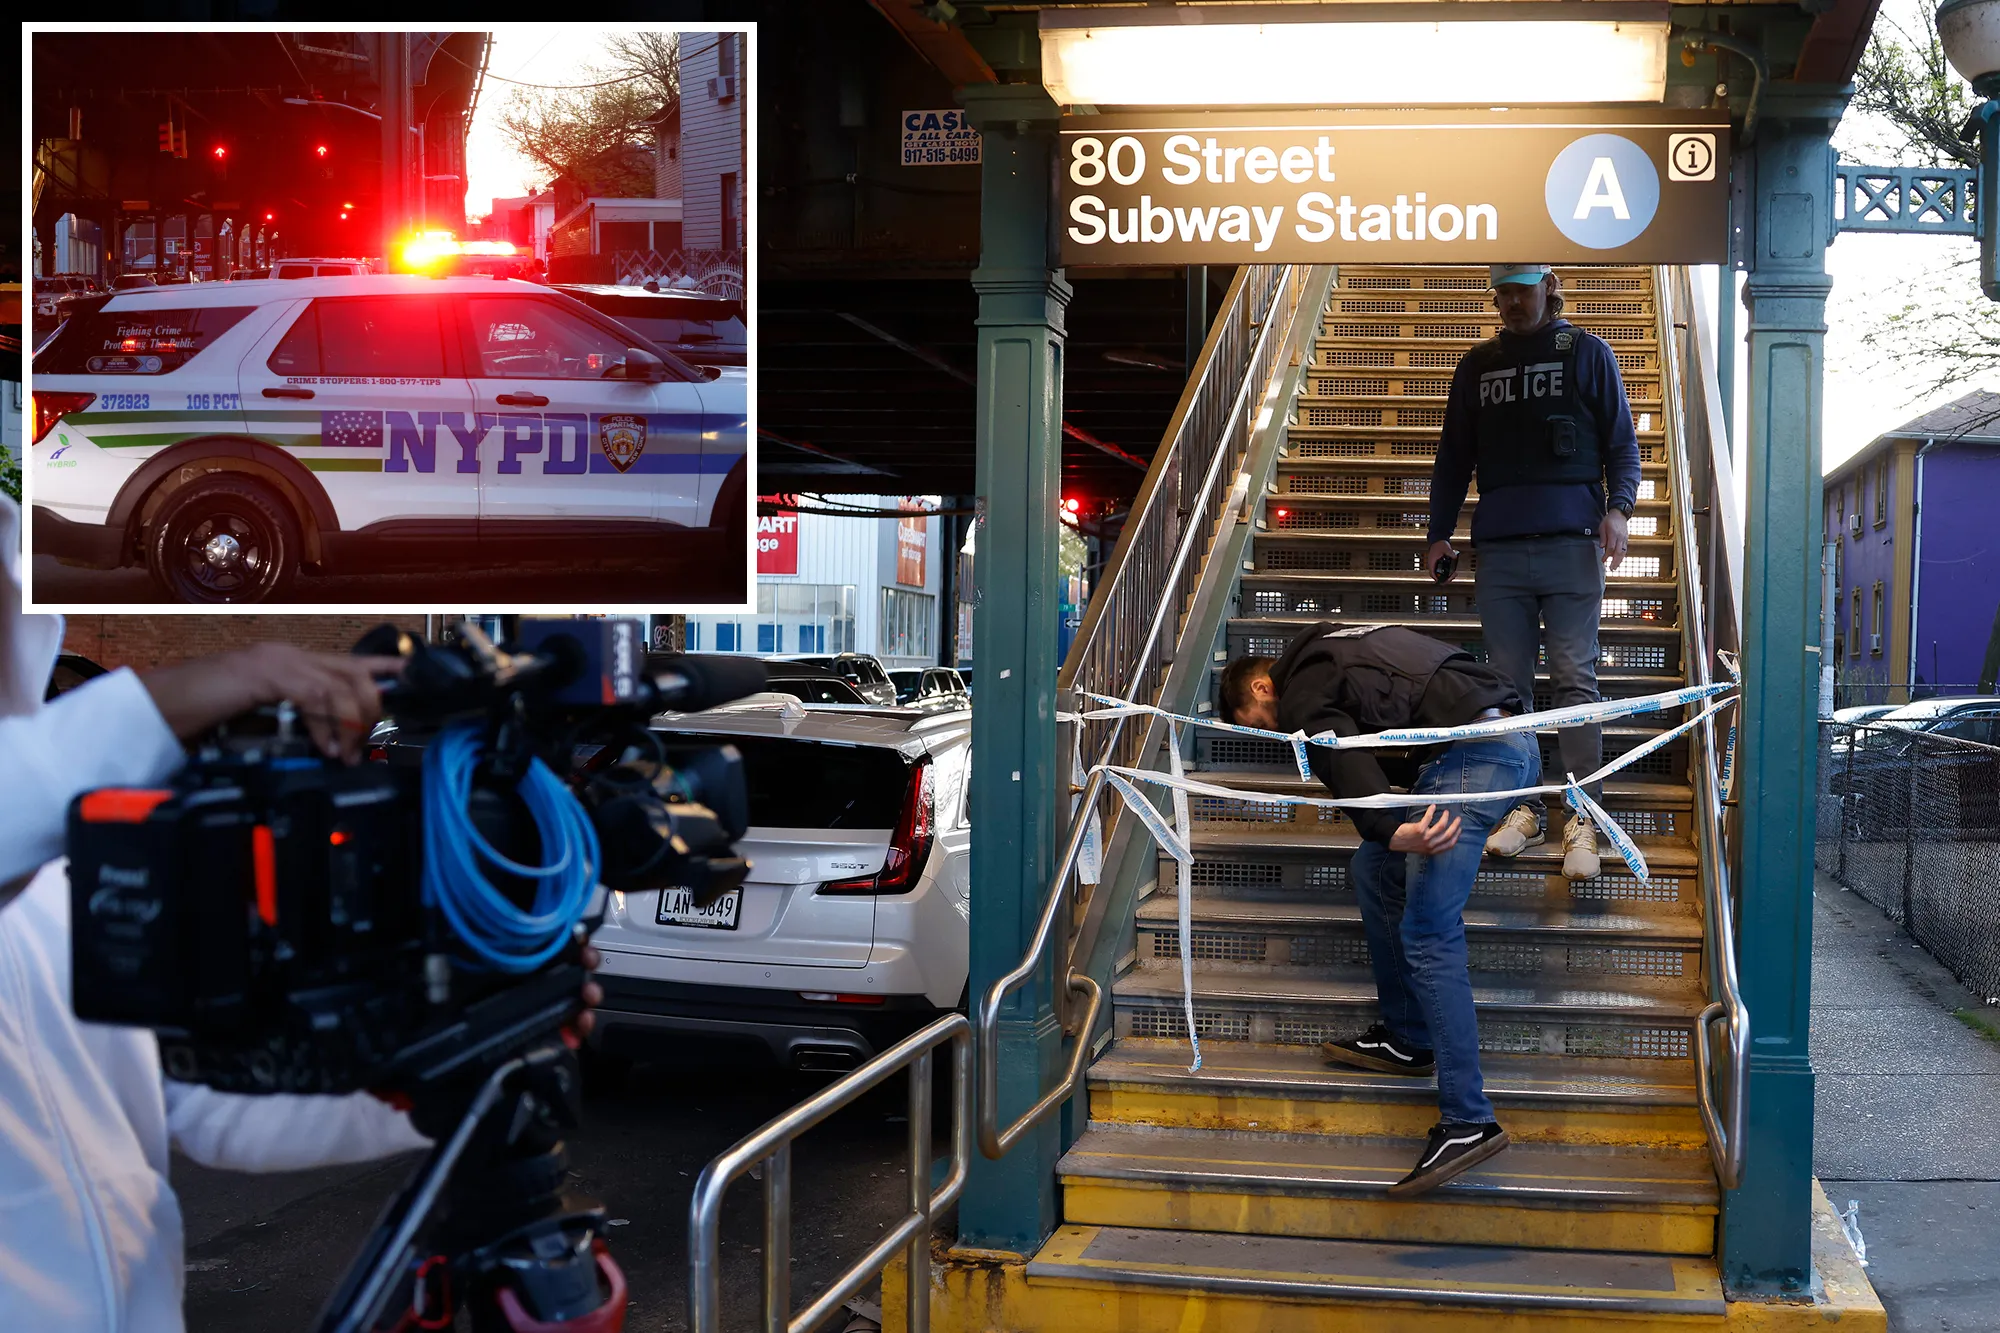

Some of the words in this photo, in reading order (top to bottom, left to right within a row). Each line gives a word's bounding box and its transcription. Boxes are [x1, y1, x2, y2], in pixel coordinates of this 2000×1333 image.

[918, 132, 940, 140] ALL
[904, 148, 978, 162] 917-515-6499
[1069, 135, 1146, 186] 80
[1162, 134, 1336, 185] Street
[1573, 157, 1630, 220] A
[1068, 195, 1284, 252] Subway
[1295, 191, 1498, 244] Station
[116, 326, 152, 337] Fighting
[155, 325, 182, 336] Crime
[150, 338, 166, 348] The
[169, 338, 196, 348] Public
[372, 378, 441, 386] 1-800-577-TIPS
[1480, 372, 1563, 407] POLICE
[102, 394, 150, 410] 372923
[186, 394, 210, 410] 106
[212, 394, 239, 410] PCT
[602, 422, 644, 432] DEPARTMENT
[384, 410, 588, 474] NYPD
[602, 438, 610, 452] CITY
[608, 453, 616, 461] OF
[629, 451, 638, 464] NEW
[636, 436, 644, 450] YORK
[46, 460, 77, 468] HYBRID
[757, 516, 796, 533] ART
[757, 538, 778, 552] ge
[1619, 843, 1634, 861] NOT
[1628, 858, 1642, 873] DO
